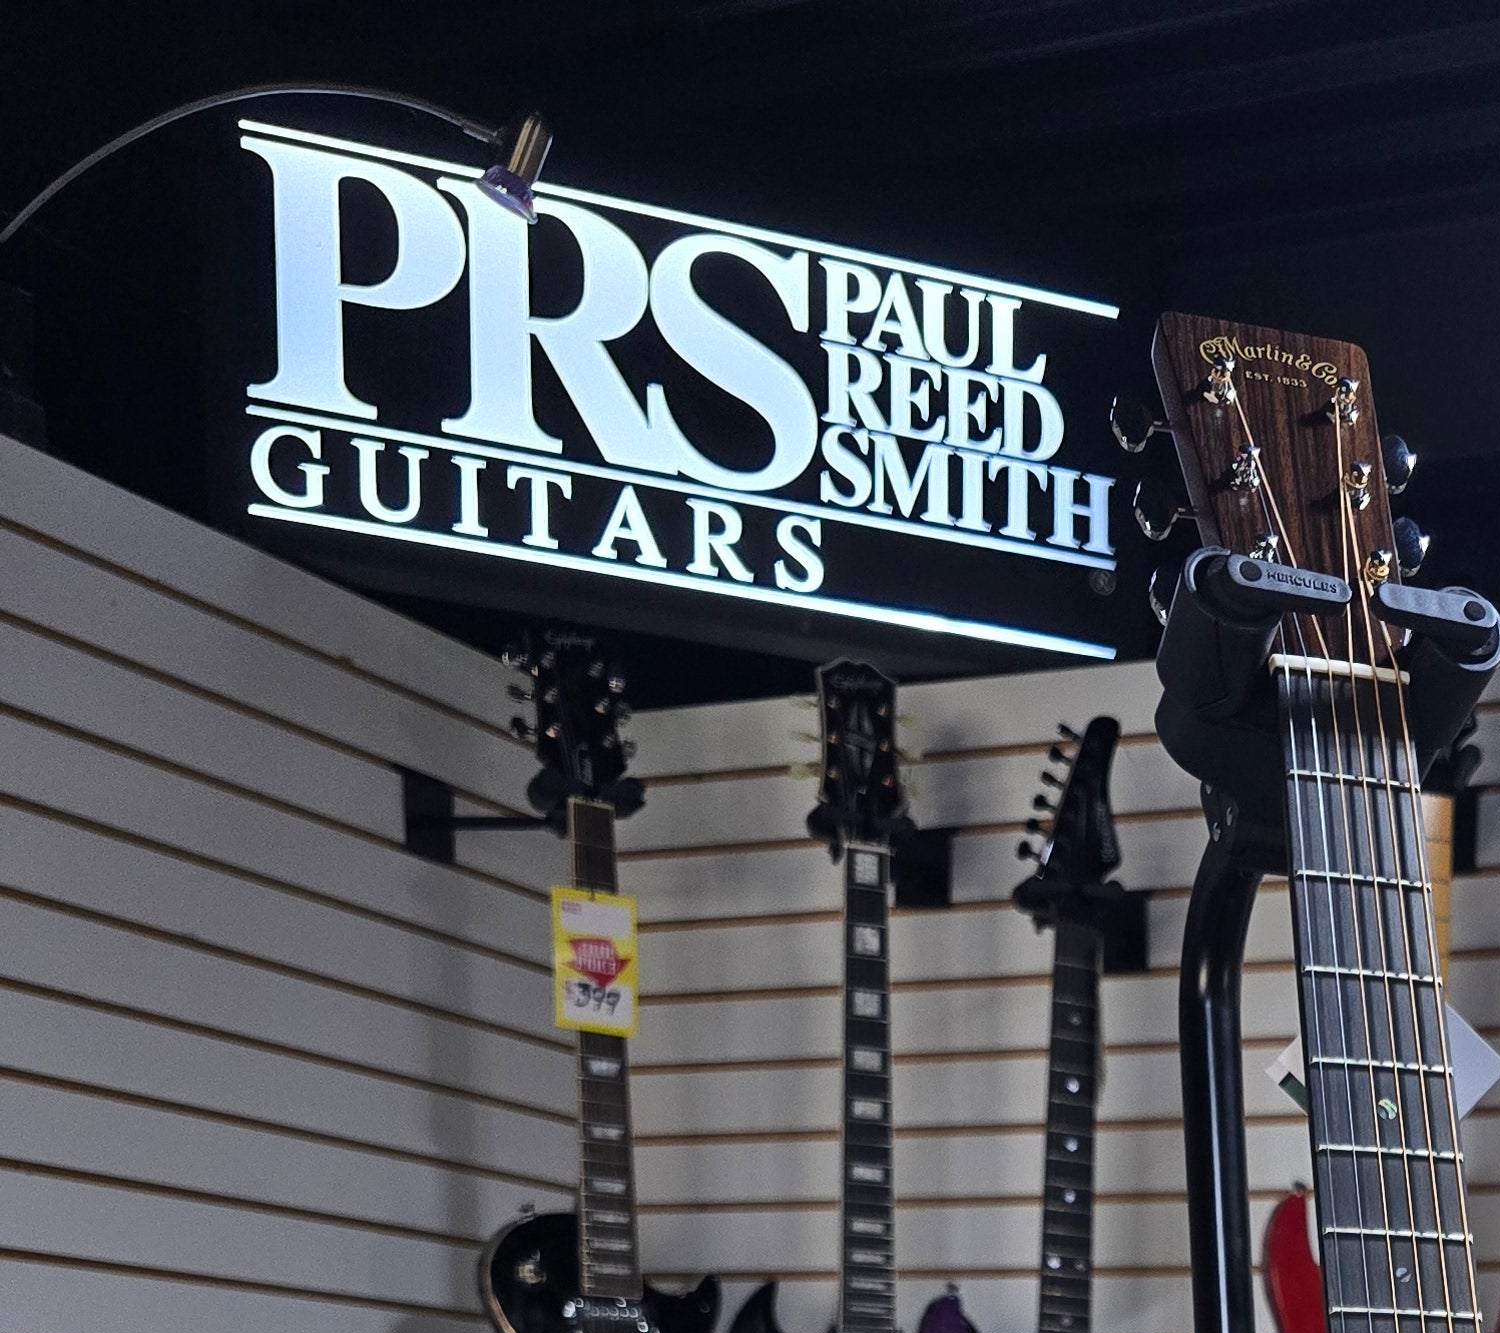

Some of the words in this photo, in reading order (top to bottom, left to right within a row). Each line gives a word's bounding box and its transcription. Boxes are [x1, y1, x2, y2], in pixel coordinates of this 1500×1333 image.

[239, 135, 819, 492] PRS
[820, 257, 1048, 384] PAUL
[821, 342, 1065, 464] REED
[1277, 376, 1308, 388] 1833
[248, 424, 825, 594] GUITARS
[820, 427, 1117, 556] SMITH
[1266, 569, 1338, 594] HERCULES
